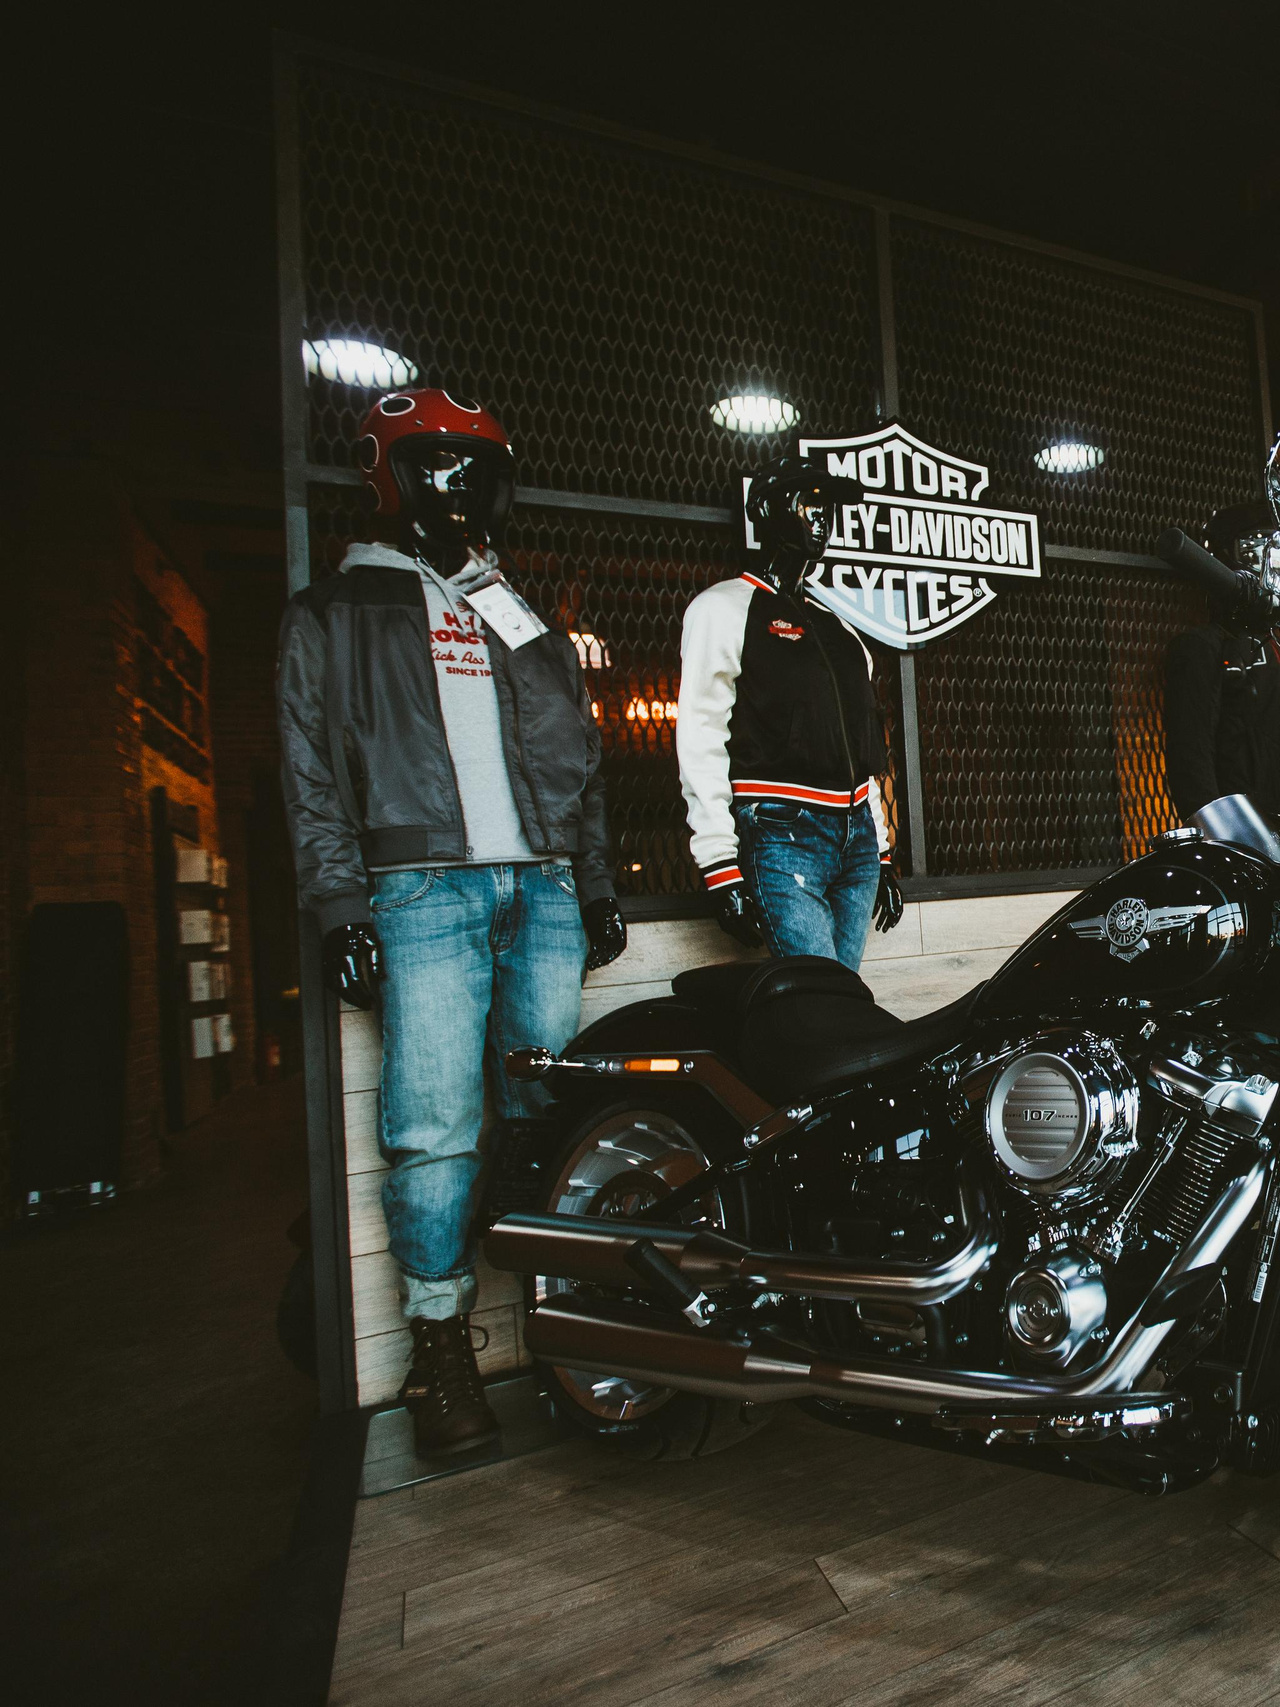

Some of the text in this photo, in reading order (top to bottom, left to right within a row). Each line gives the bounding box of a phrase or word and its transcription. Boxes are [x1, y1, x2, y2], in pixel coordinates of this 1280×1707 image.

[827, 438, 968, 501] MOTOR
[829, 503, 1028, 566] LEY-DAVIDSON
[832, 563, 972, 632] CYCLES
[445, 666, 493, 677] SINCE 19
[1110, 899, 1144, 918] HARLEY
[1108, 919, 1145, 944] DAVIDSON
[1023, 1109, 1057, 1122] 107
